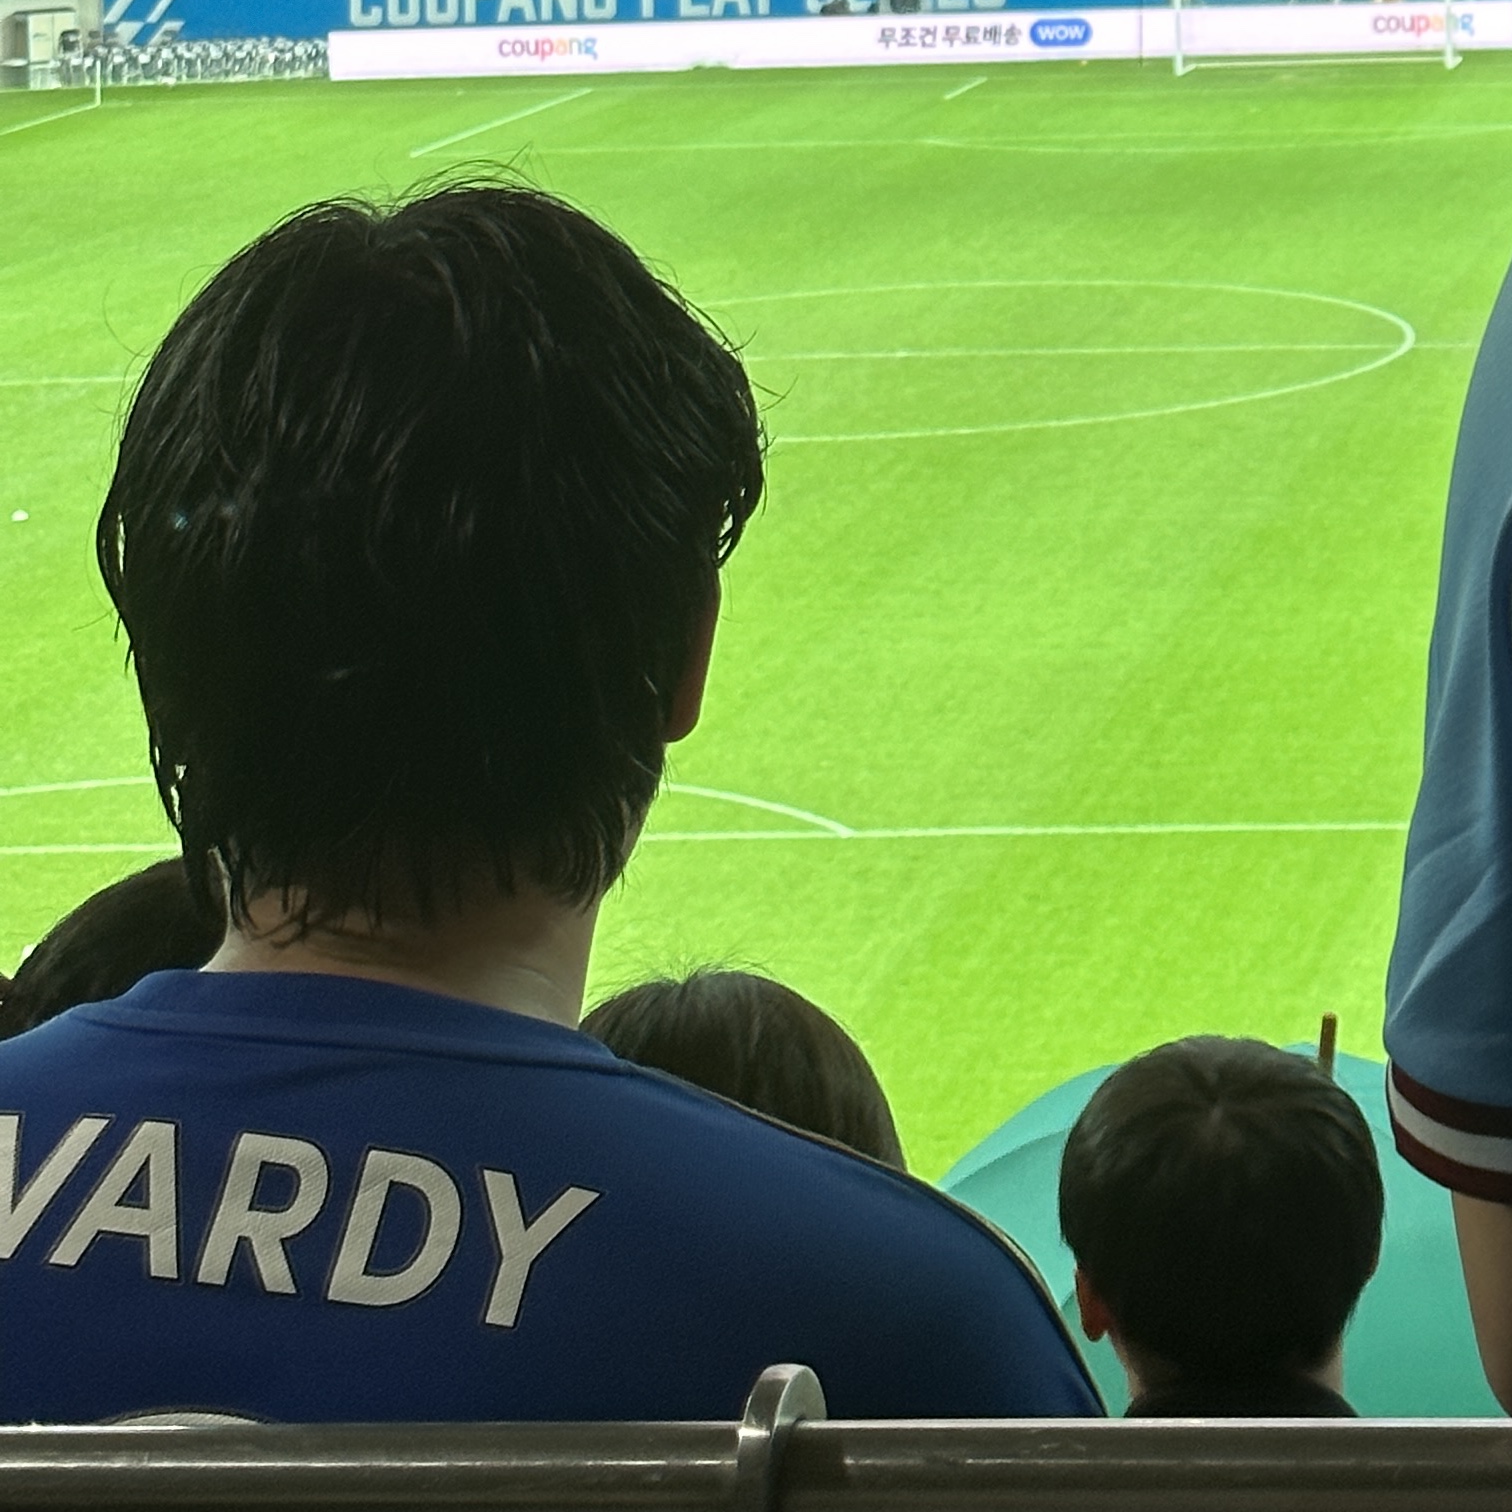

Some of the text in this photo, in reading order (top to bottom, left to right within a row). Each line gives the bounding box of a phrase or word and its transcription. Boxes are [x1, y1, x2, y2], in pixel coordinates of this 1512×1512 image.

[877, 22, 1023, 50] 무조건 무료배송
[1036, 24, 1088, 42] WOW
[497, 36, 598, 61] coupang
[0, 1111, 601, 1329] VARDY
